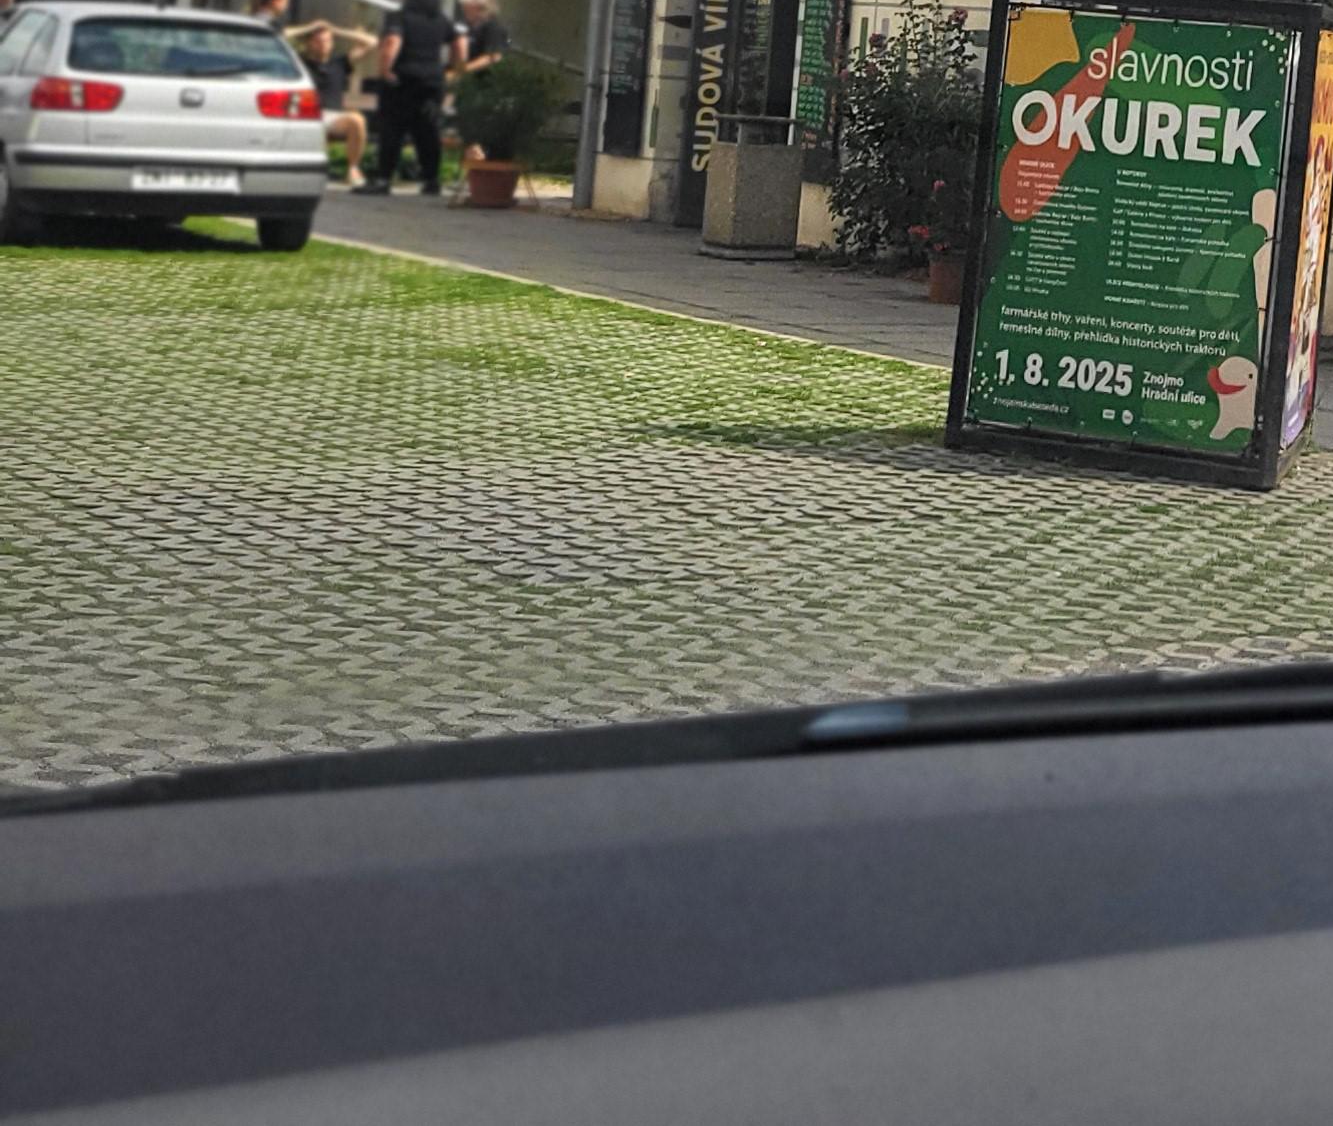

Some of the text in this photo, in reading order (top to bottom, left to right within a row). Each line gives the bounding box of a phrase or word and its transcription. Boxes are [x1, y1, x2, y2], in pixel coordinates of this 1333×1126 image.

[1087, 36, 1254, 91] slavnosti
[691, 43, 726, 173] SUDOVÁ
[1012, 90, 1267, 167] OKUREK
[999, 321, 1043, 335] řemeslné
[1074, 331, 1120, 345] přehlídka
[1122, 336, 1183, 352] historických
[1185, 343, 1226, 357] traktorů
[1001, 304, 1049, 321] farmářské
[1110, 317, 1156, 334] koncerty,
[1158, 324, 1196, 338] soutěže
[1199, 329, 1217, 341] pro
[1023, 353, 1049, 387] 8.
[1057, 356, 1134, 397] 2025
[1142, 371, 1185, 388] Znojmo
[1141, 386, 1206, 405] Hradní ulice
